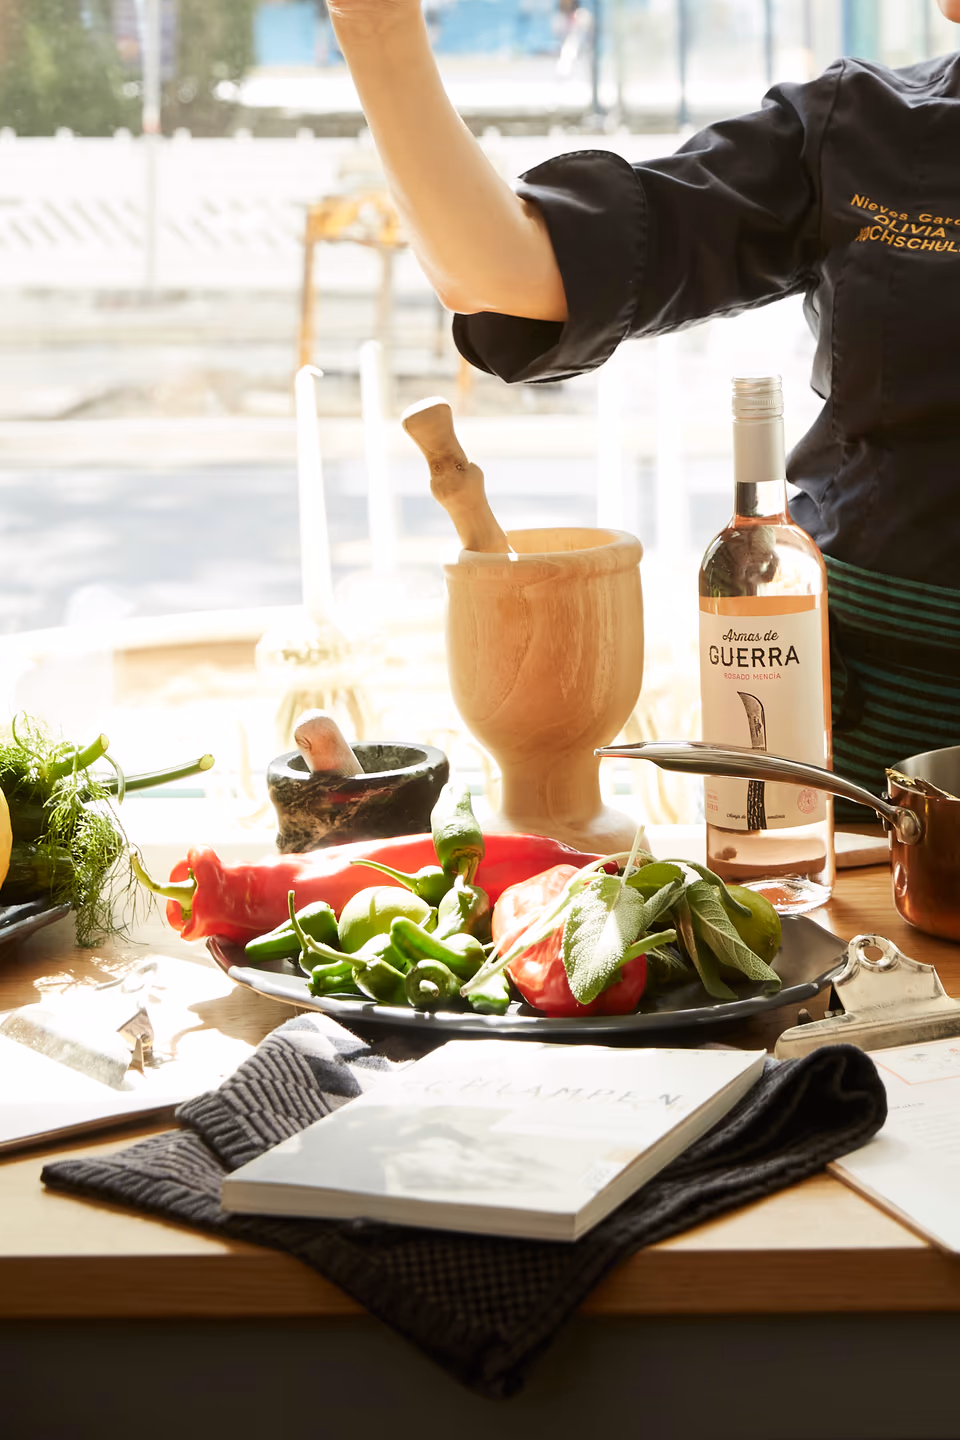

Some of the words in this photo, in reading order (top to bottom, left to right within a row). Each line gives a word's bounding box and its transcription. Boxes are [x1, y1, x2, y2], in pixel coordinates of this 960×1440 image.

[850, 193, 908, 221] Nieves
[873, 214, 946, 238] OLIVIA
[722, 628, 762, 642] Armas
[763, 629, 779, 642] de
[709, 645, 800, 668] GUERRA
[723, 672, 750, 680] ROSADO
